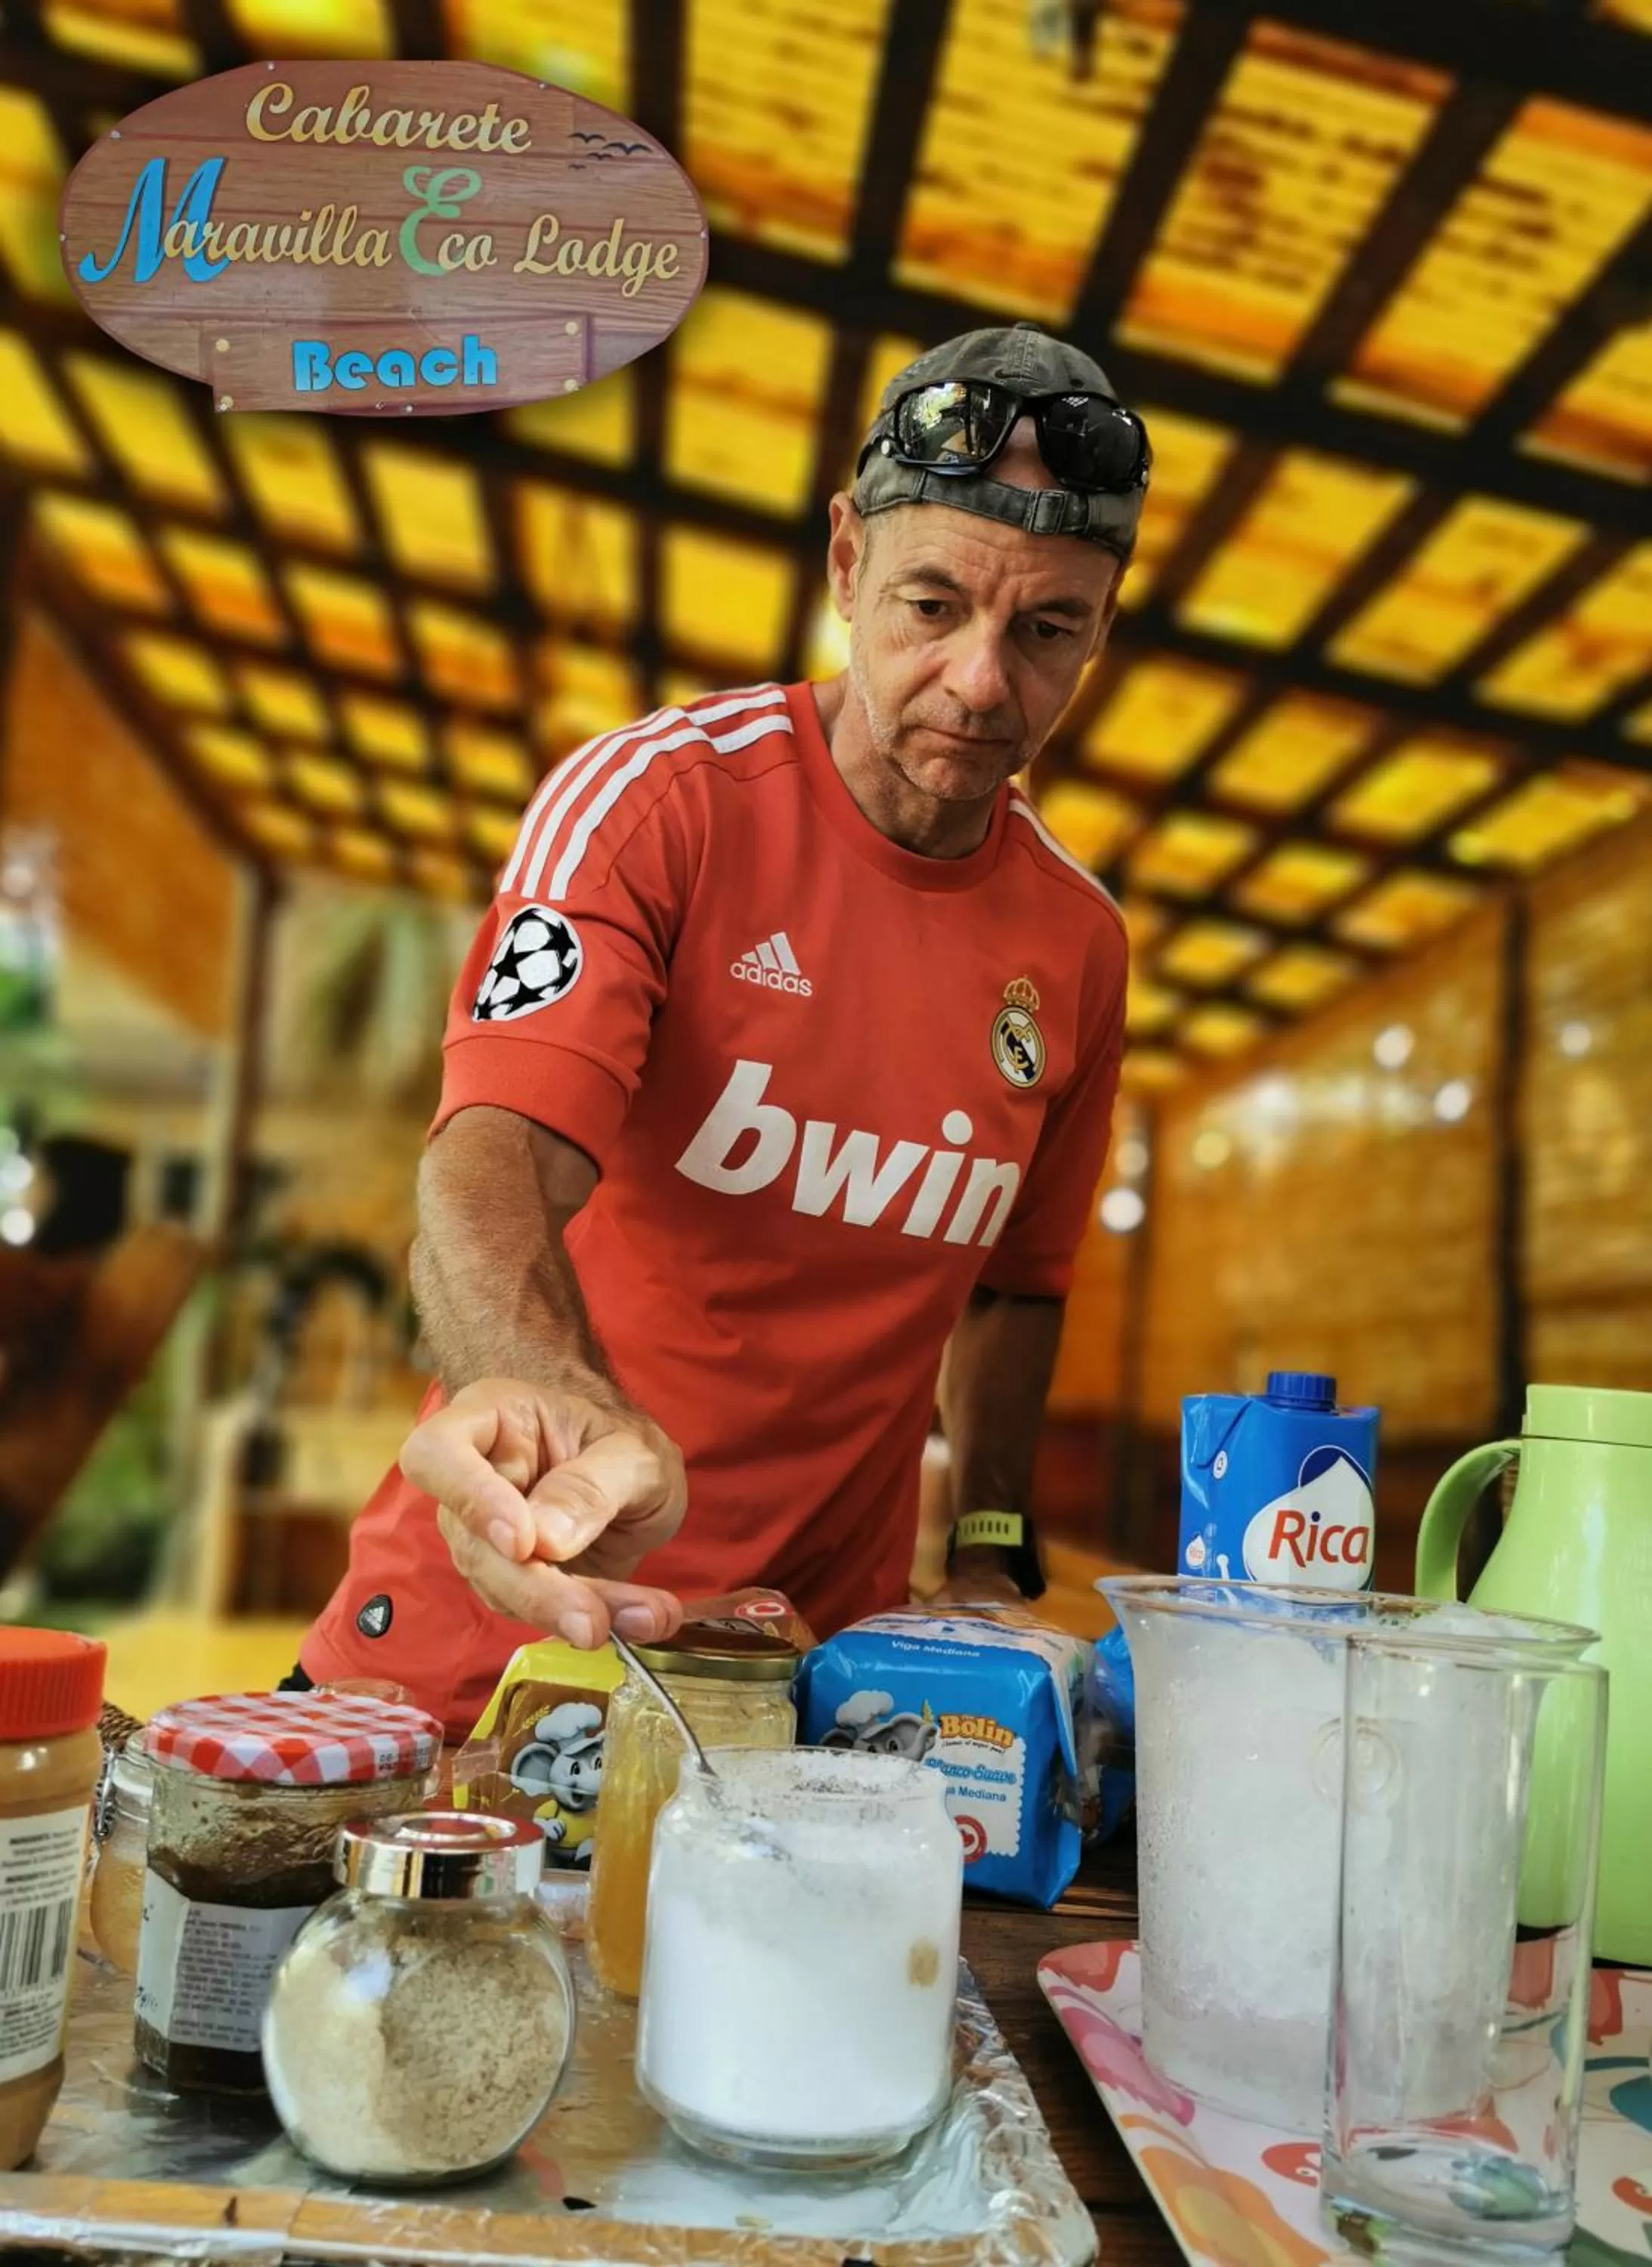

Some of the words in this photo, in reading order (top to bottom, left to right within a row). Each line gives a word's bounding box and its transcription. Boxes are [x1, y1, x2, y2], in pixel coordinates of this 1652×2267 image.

[730, 960, 813, 997] adidas
[674, 1059, 1020, 1247] bwin
[1268, 1509, 1369, 1568] Rica
[958, 1784, 1007, 1802] Mediana
